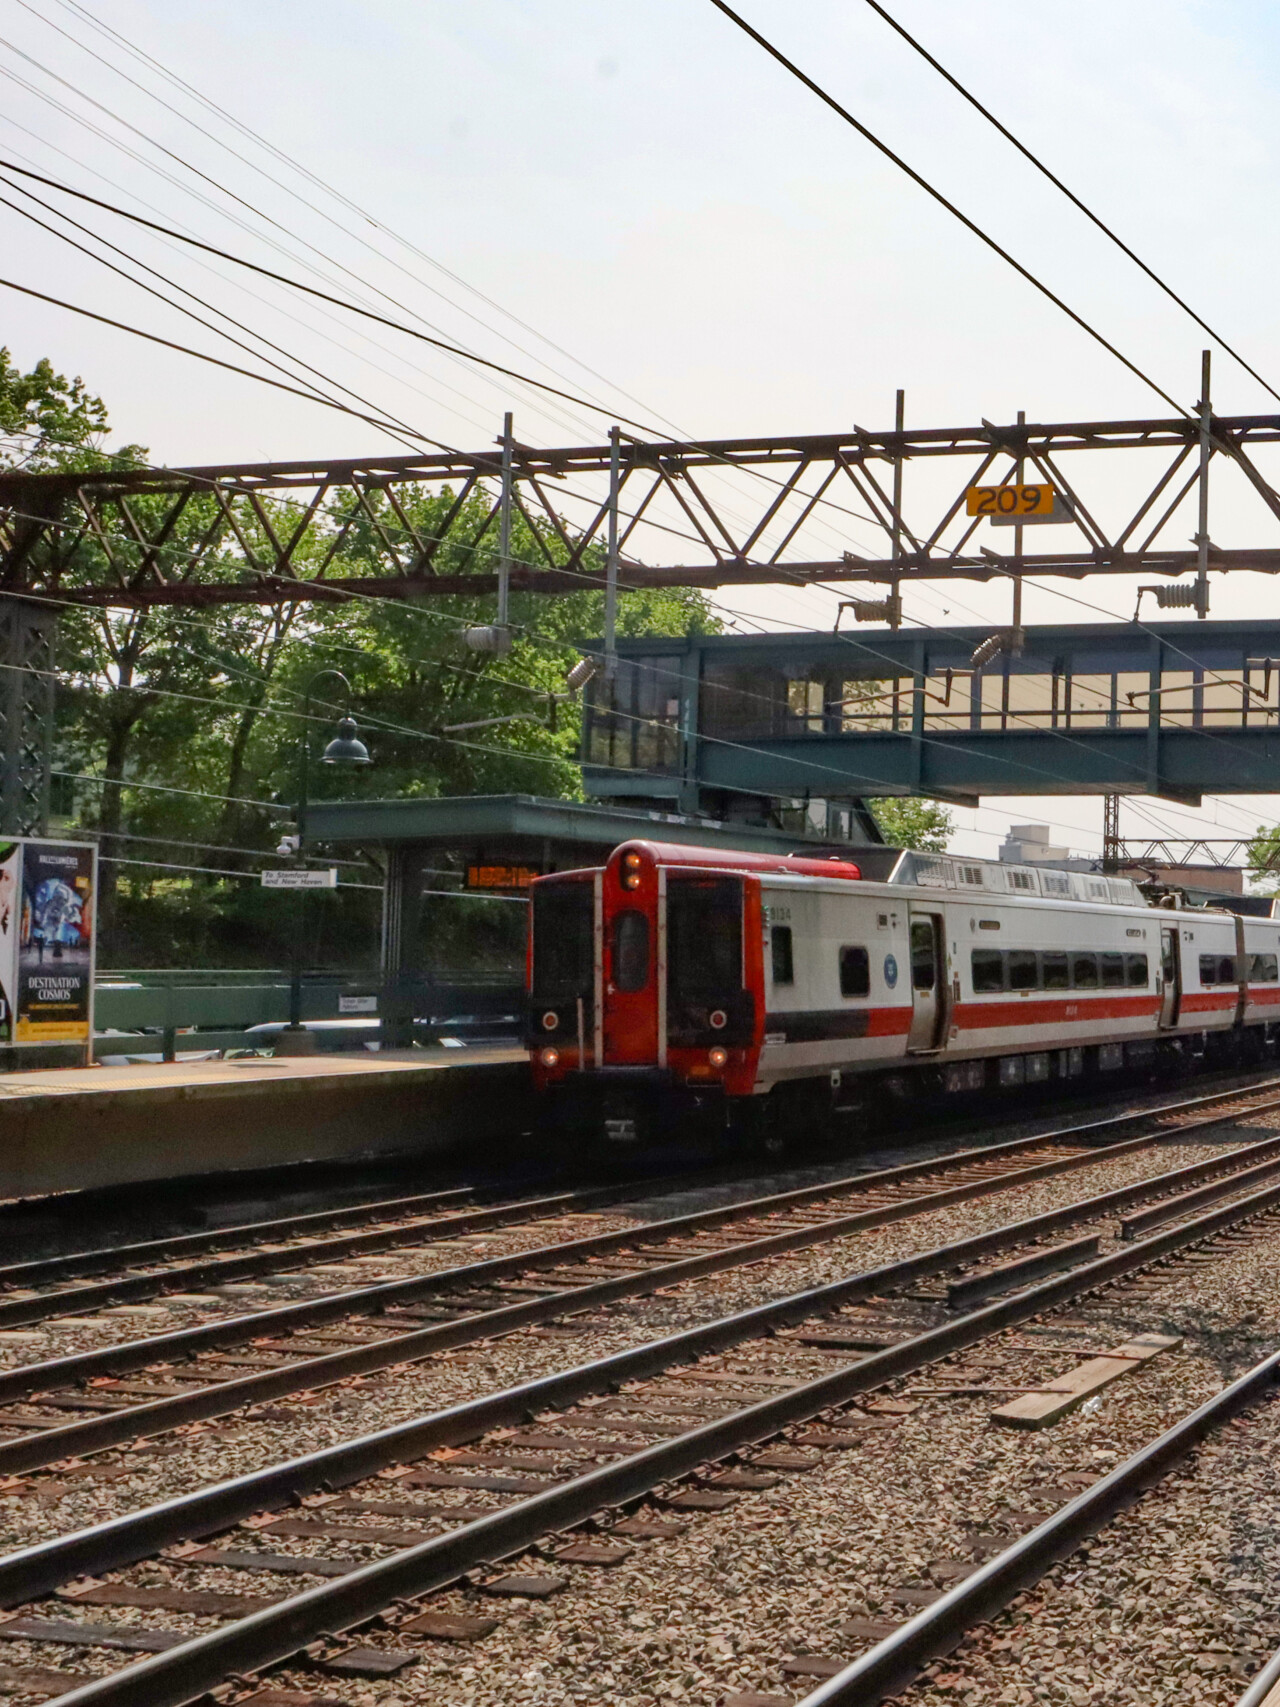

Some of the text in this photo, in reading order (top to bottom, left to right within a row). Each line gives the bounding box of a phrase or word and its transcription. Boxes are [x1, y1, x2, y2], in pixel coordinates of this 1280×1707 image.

[977, 486, 1041, 514] 209
[28, 977, 80, 989] DESTINATION
[38, 989, 71, 1000] COSMOS
